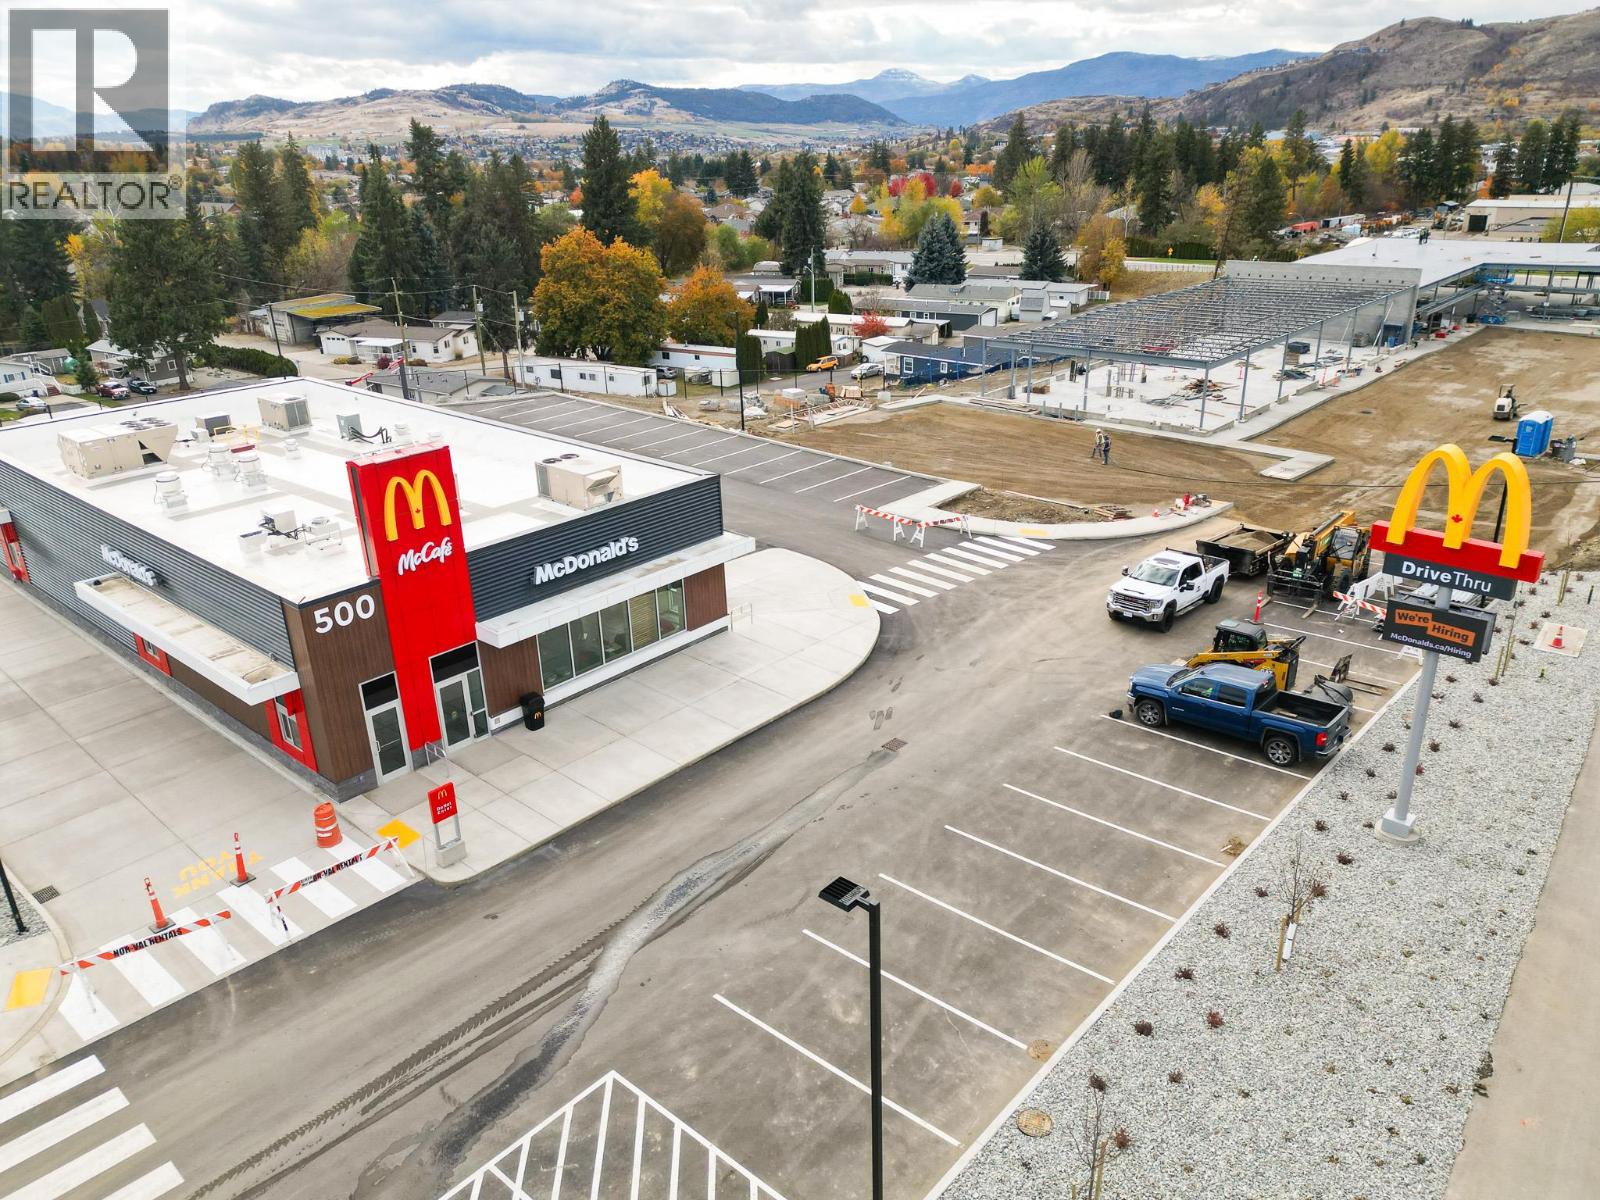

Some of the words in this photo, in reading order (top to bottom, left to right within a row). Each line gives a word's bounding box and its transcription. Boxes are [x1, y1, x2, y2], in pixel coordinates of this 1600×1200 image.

[534, 537, 639, 585] McDonald's
[314, 594, 375, 634] 500
[1397, 611, 1430, 624] We're
[1432, 624, 1470, 643] Hiring
[1390, 632, 1472, 659] McDonalds.ca/Hiring
[147, 927, 183, 945] RENTALS
